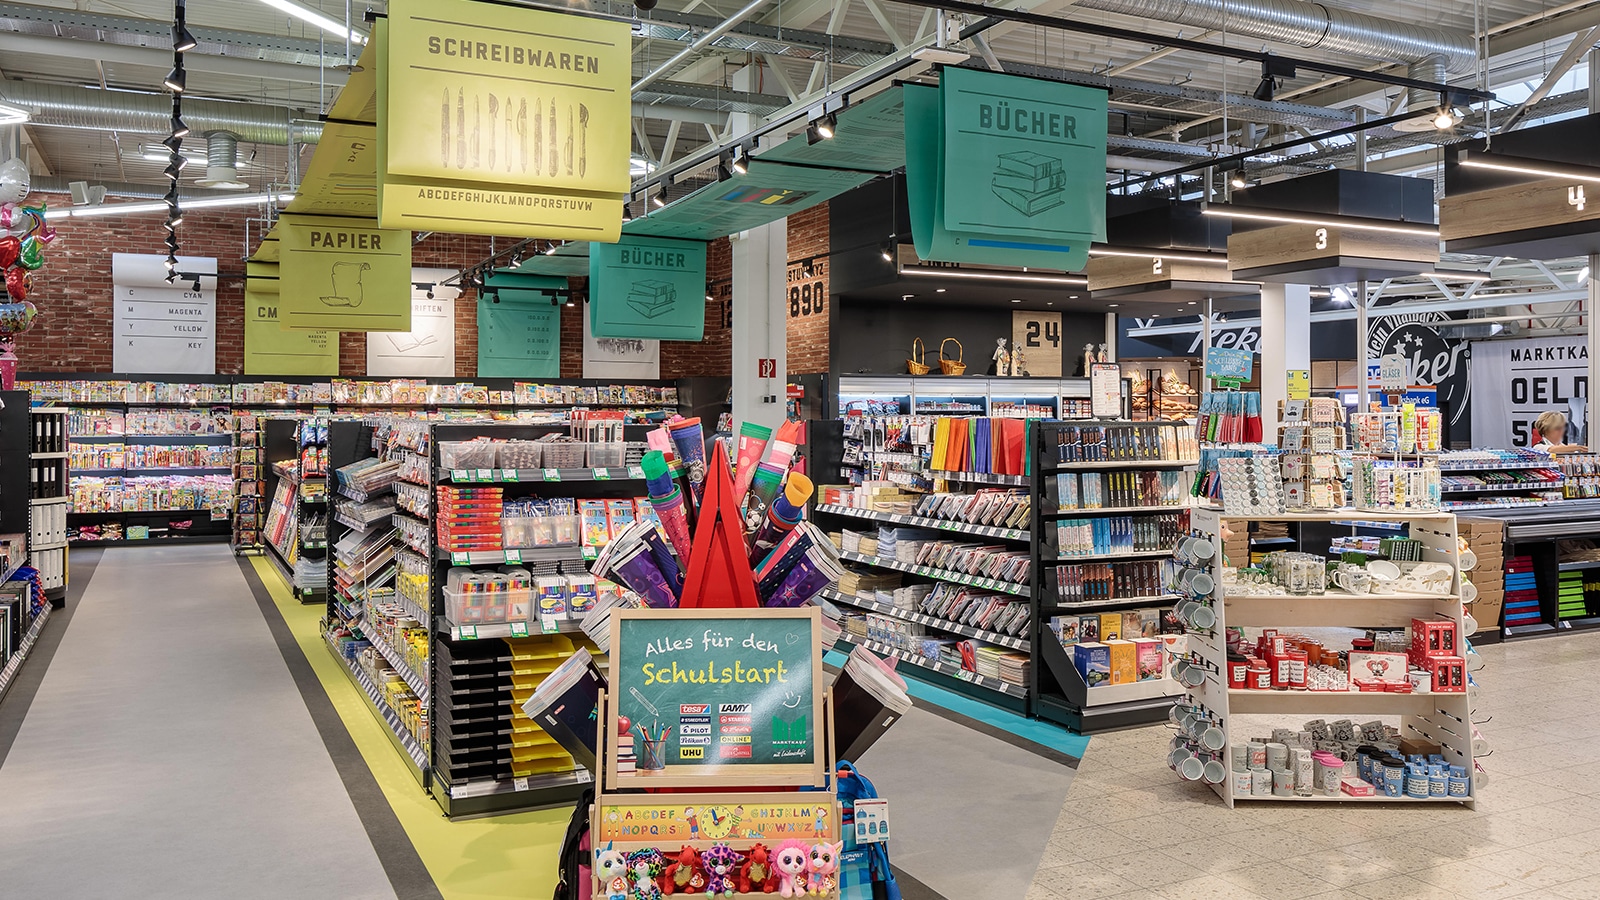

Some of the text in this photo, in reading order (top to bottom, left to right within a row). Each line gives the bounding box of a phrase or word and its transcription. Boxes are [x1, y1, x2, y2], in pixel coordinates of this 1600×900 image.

[428, 36, 600, 75] SCHREIBWAREN
[979, 101, 1077, 139] BÜCHER
[418, 188, 594, 211] ABCDEFGHIJKLMNOPQRSTUVW
[1568, 185, 1586, 211] 4
[310, 231, 382, 250] PAPIER
[1315, 228, 1328, 250] 3
[620, 248, 686, 268] BÜCHER
[1152, 257, 1162, 274] 2
[257, 307, 278, 318] CM
[791, 282, 823, 317] 890
[1026, 321, 1060, 348] 24
[1411, 340, 1469, 386] ker
[1511, 346, 1588, 361] MARKTKA
[645, 629, 780, 657] Alles für den
[641, 660, 788, 686] Schulstart
